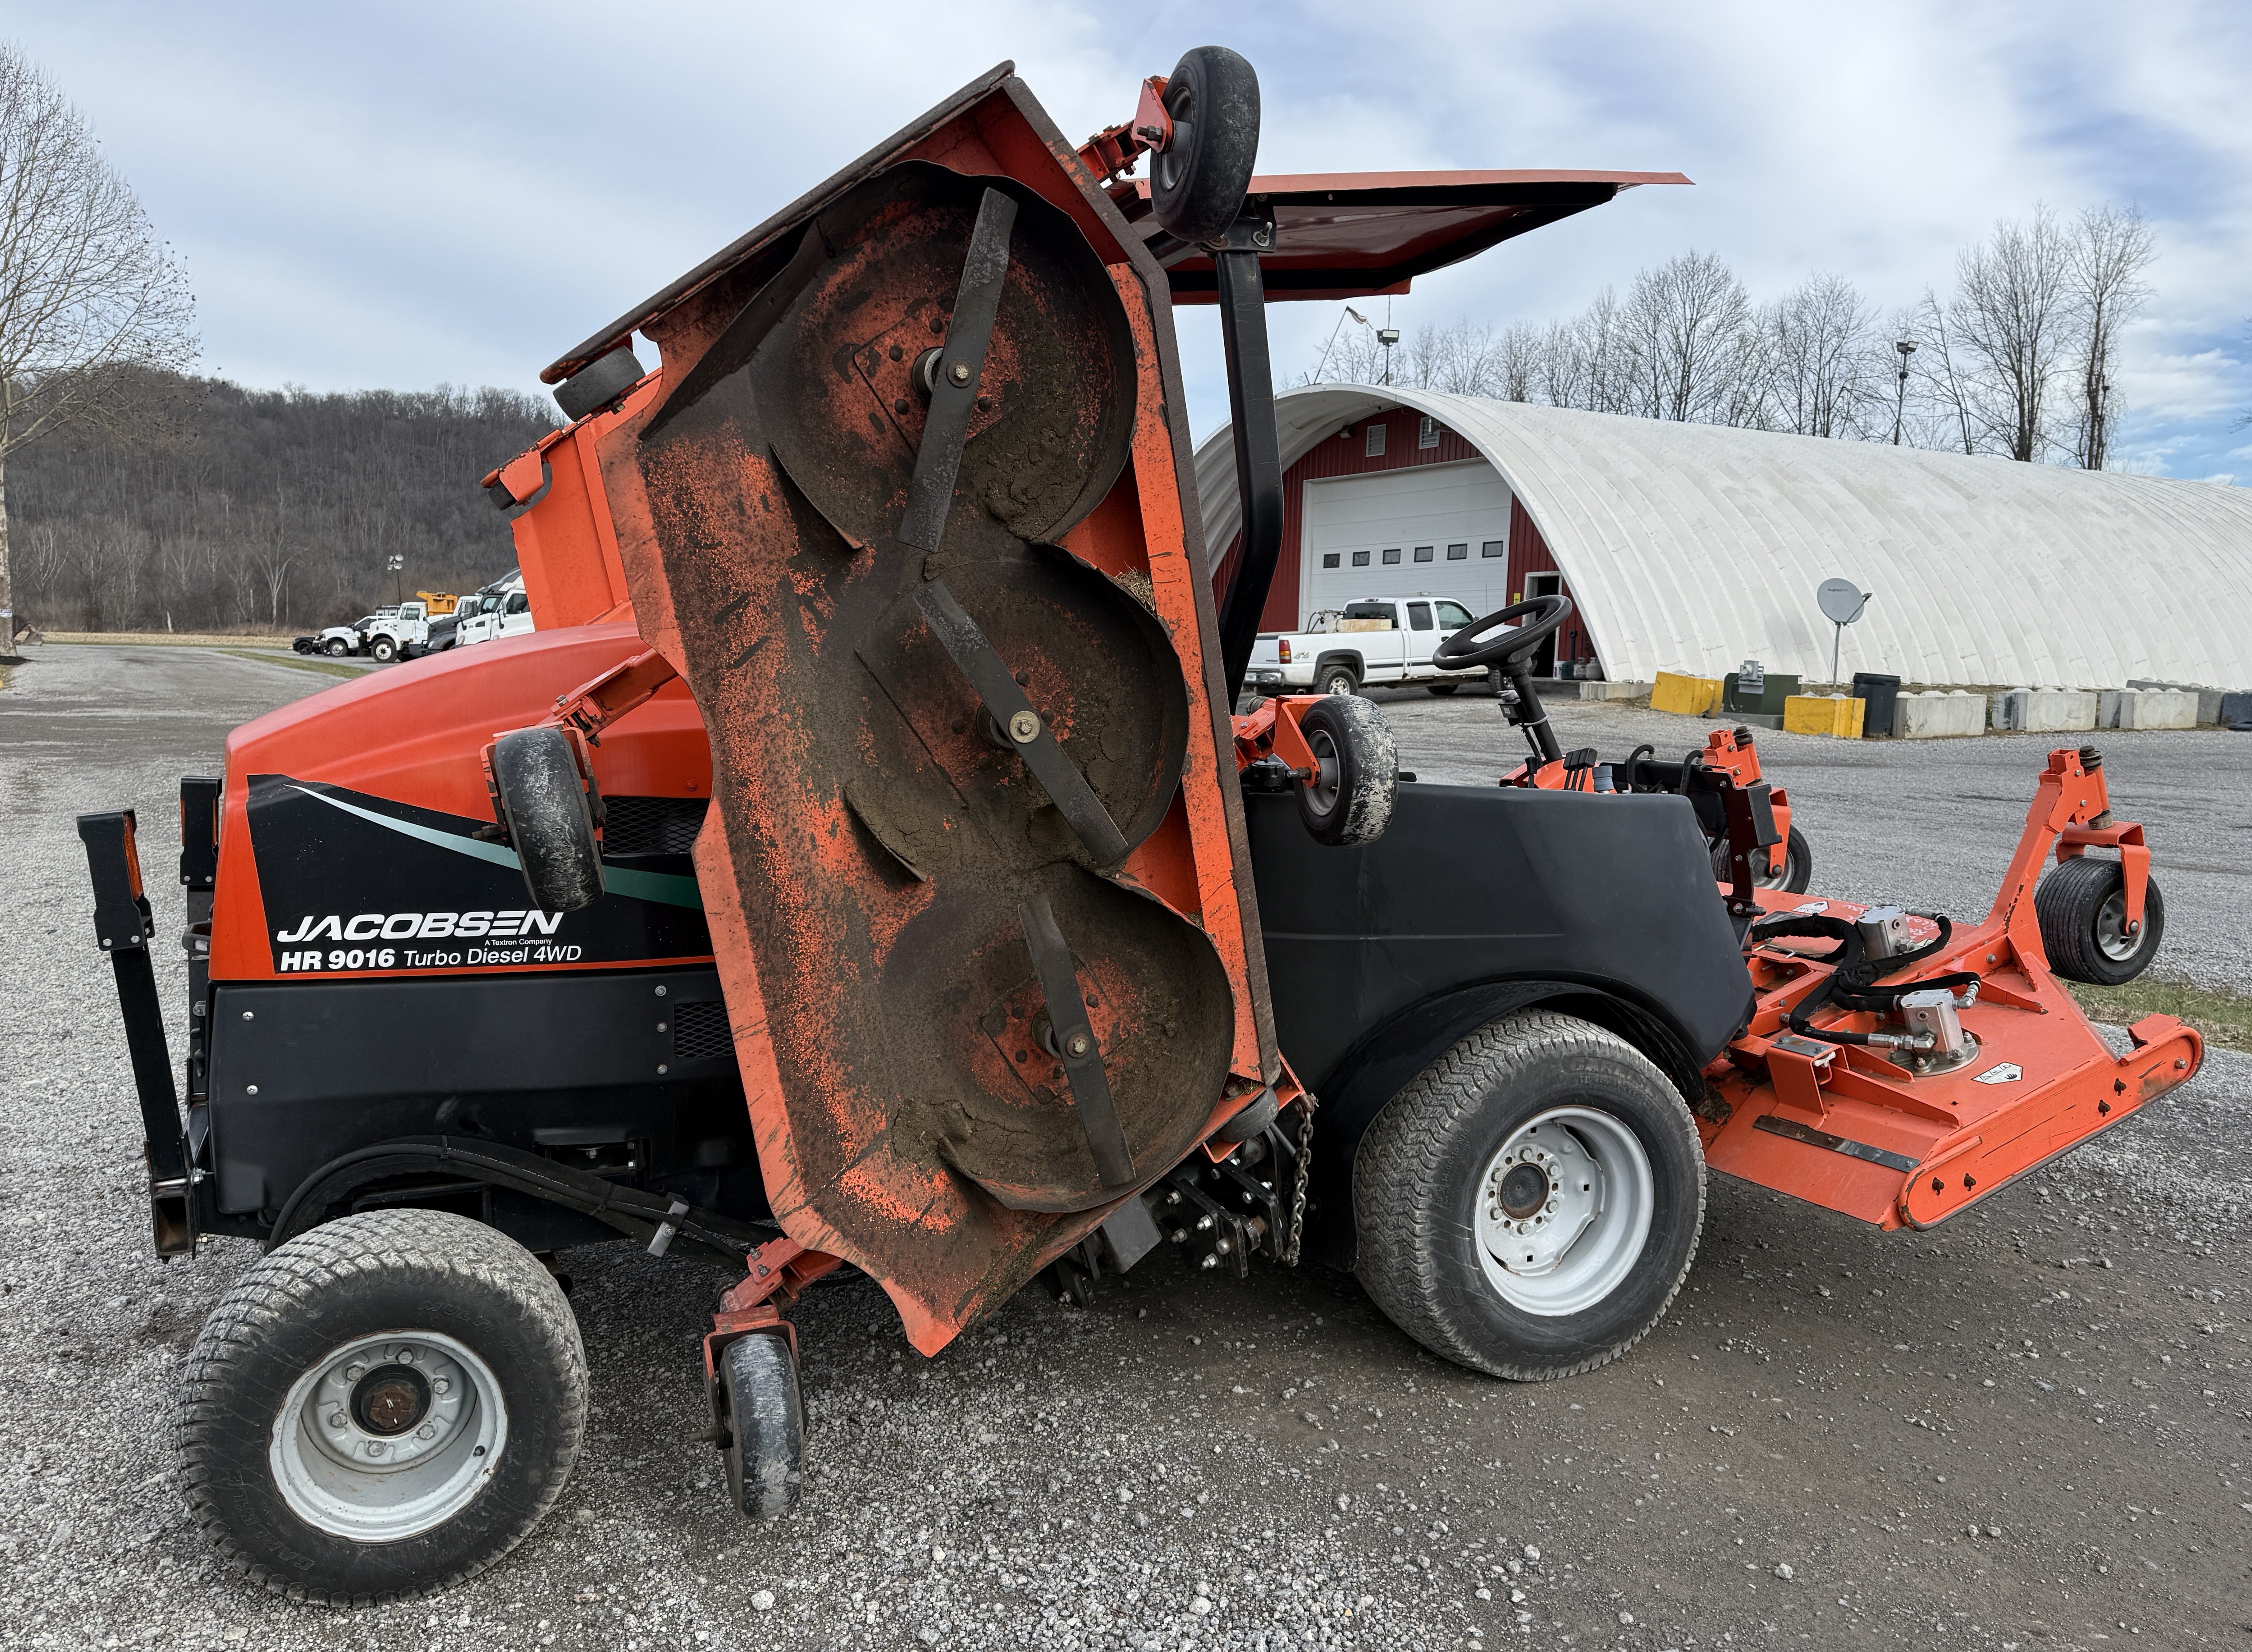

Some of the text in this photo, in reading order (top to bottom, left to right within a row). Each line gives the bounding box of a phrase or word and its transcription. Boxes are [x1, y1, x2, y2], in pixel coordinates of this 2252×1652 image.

[277, 910, 564, 942] JACOBSEN
[280, 945, 582, 971] HR 9016 Turbo Diesel 4WD
[226, 1471, 315, 1570] CARLISLE
